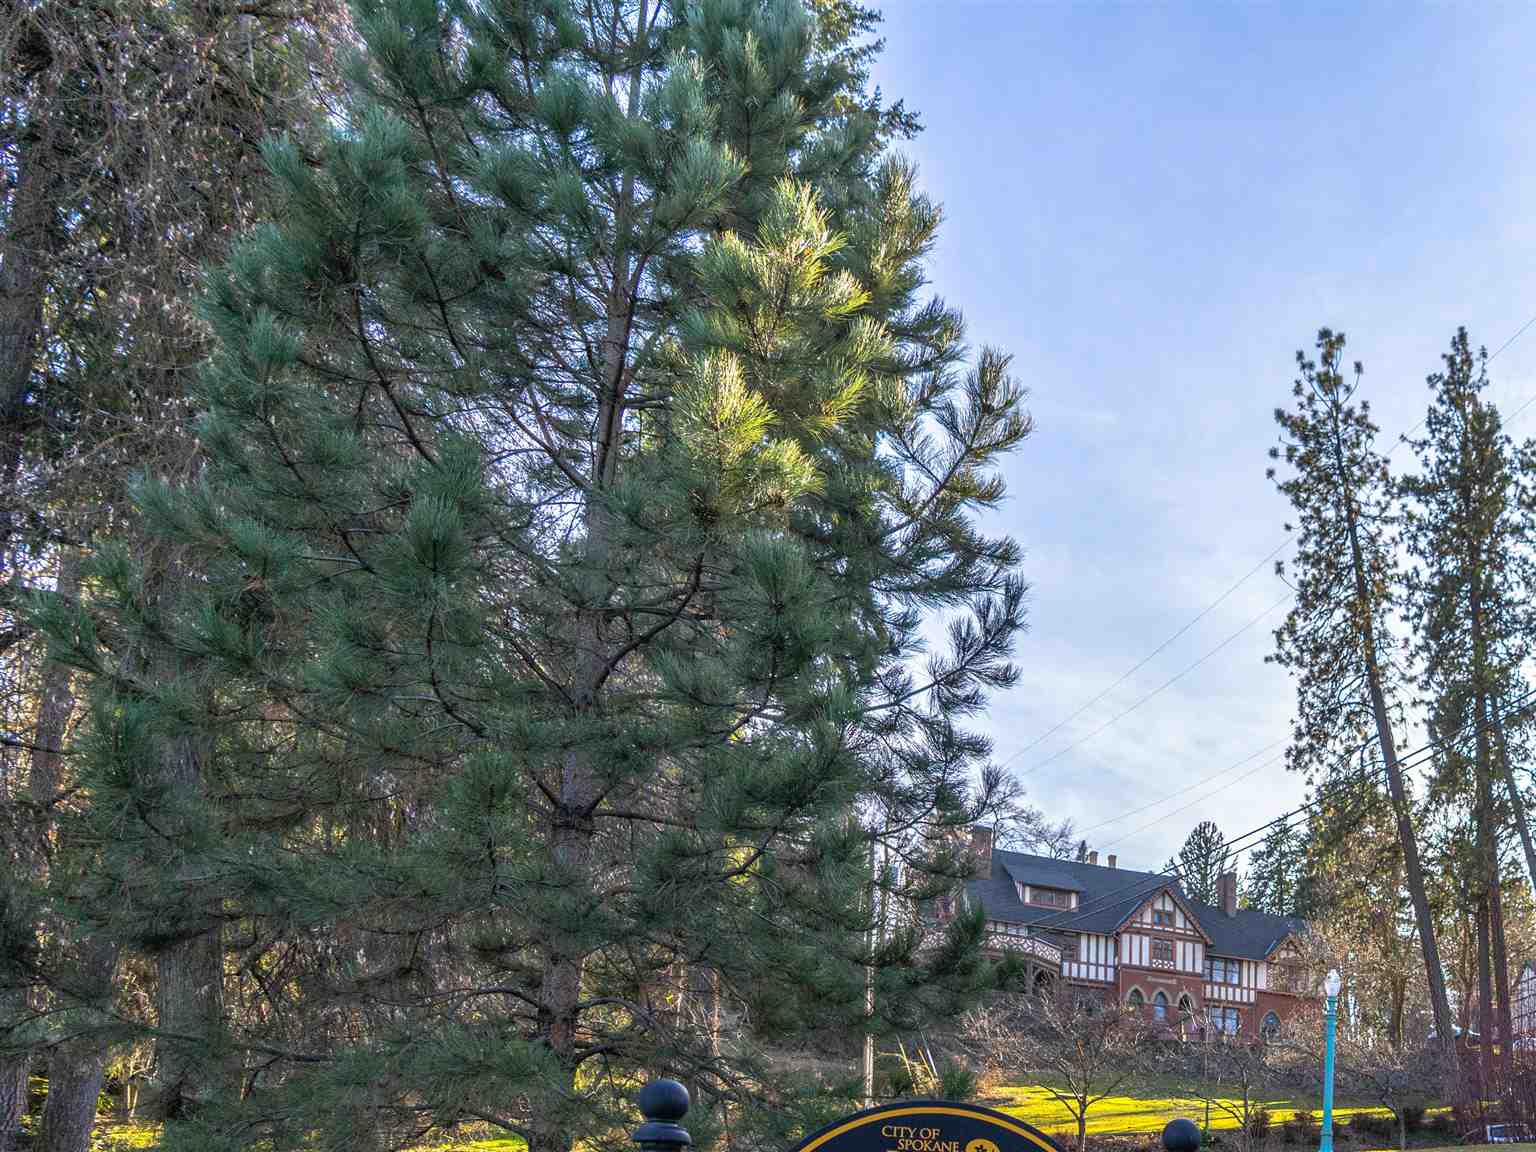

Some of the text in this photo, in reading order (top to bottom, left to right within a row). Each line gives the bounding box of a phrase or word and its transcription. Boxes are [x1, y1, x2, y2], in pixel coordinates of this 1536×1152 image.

[881, 1125, 940, 1139] CITY OF
[897, 1139, 960, 1152] SPOKANE
